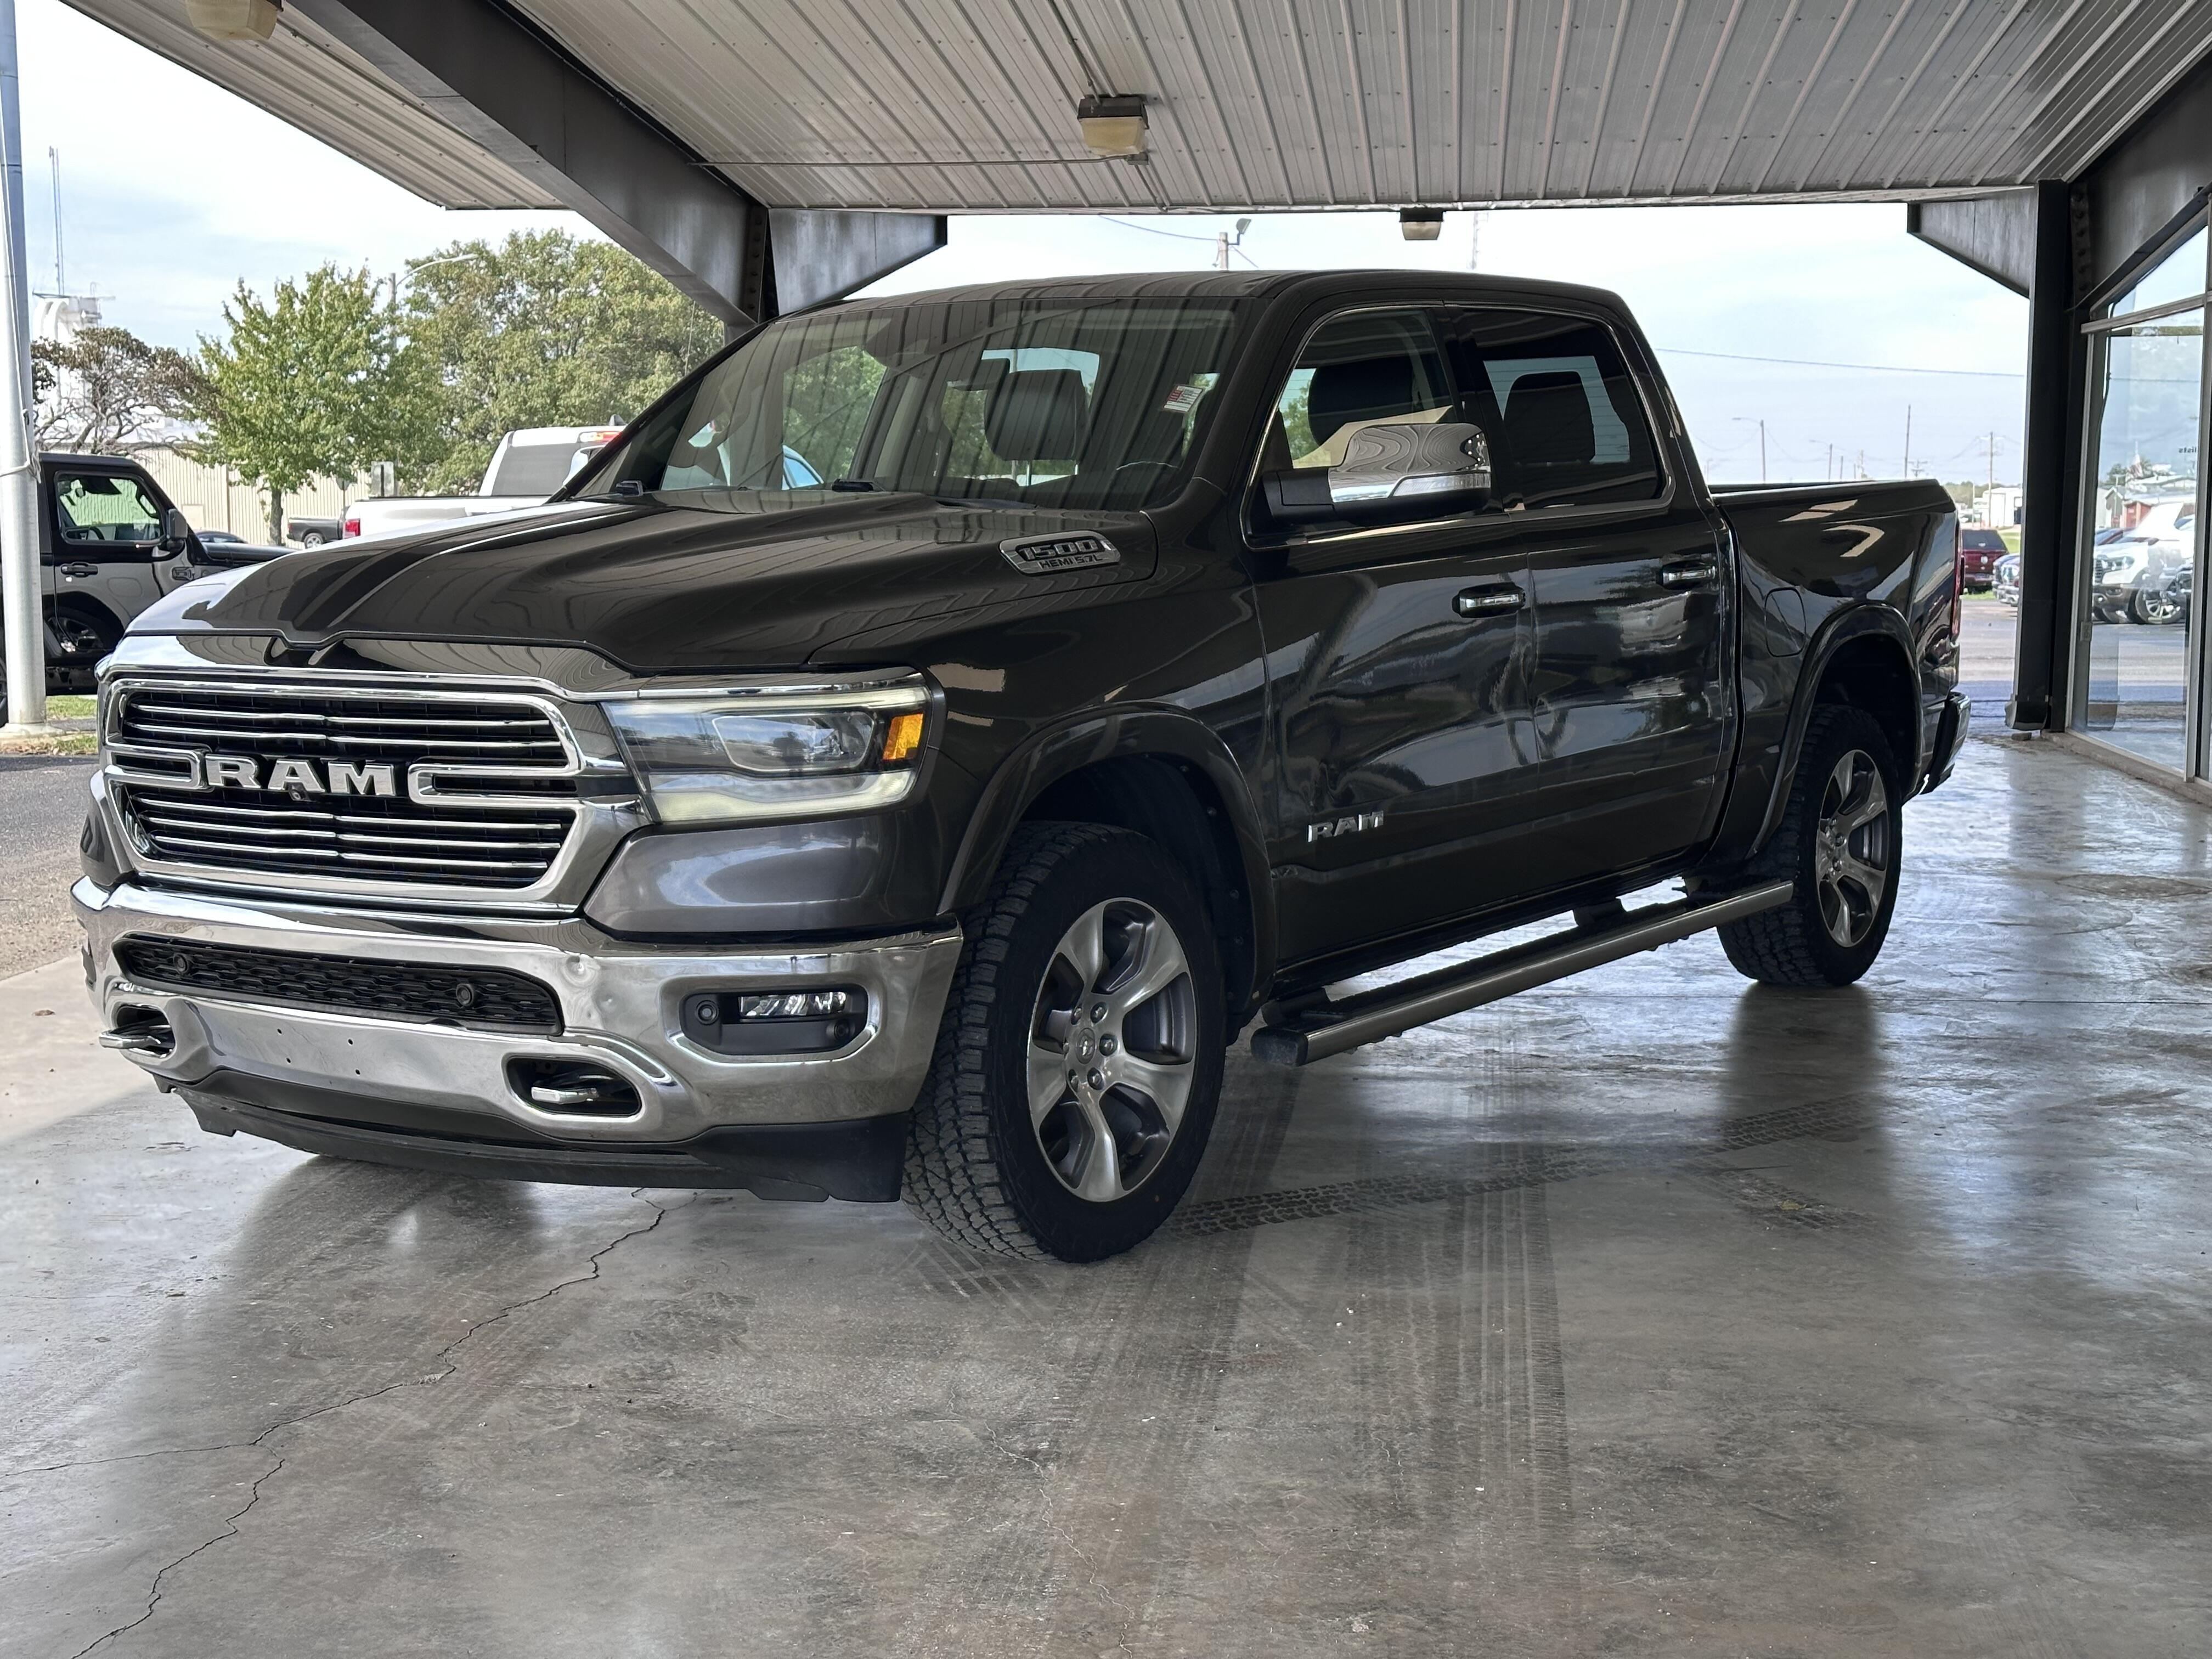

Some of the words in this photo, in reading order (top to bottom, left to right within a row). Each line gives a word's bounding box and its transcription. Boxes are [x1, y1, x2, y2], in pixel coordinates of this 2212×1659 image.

[1019, 540, 1097, 560] 1500
[1039, 557, 1074, 569] HEMI
[1075, 554, 1103, 564] 5.7L
[205, 753, 396, 796] RAM
[1308, 810, 1384, 843] RAM
